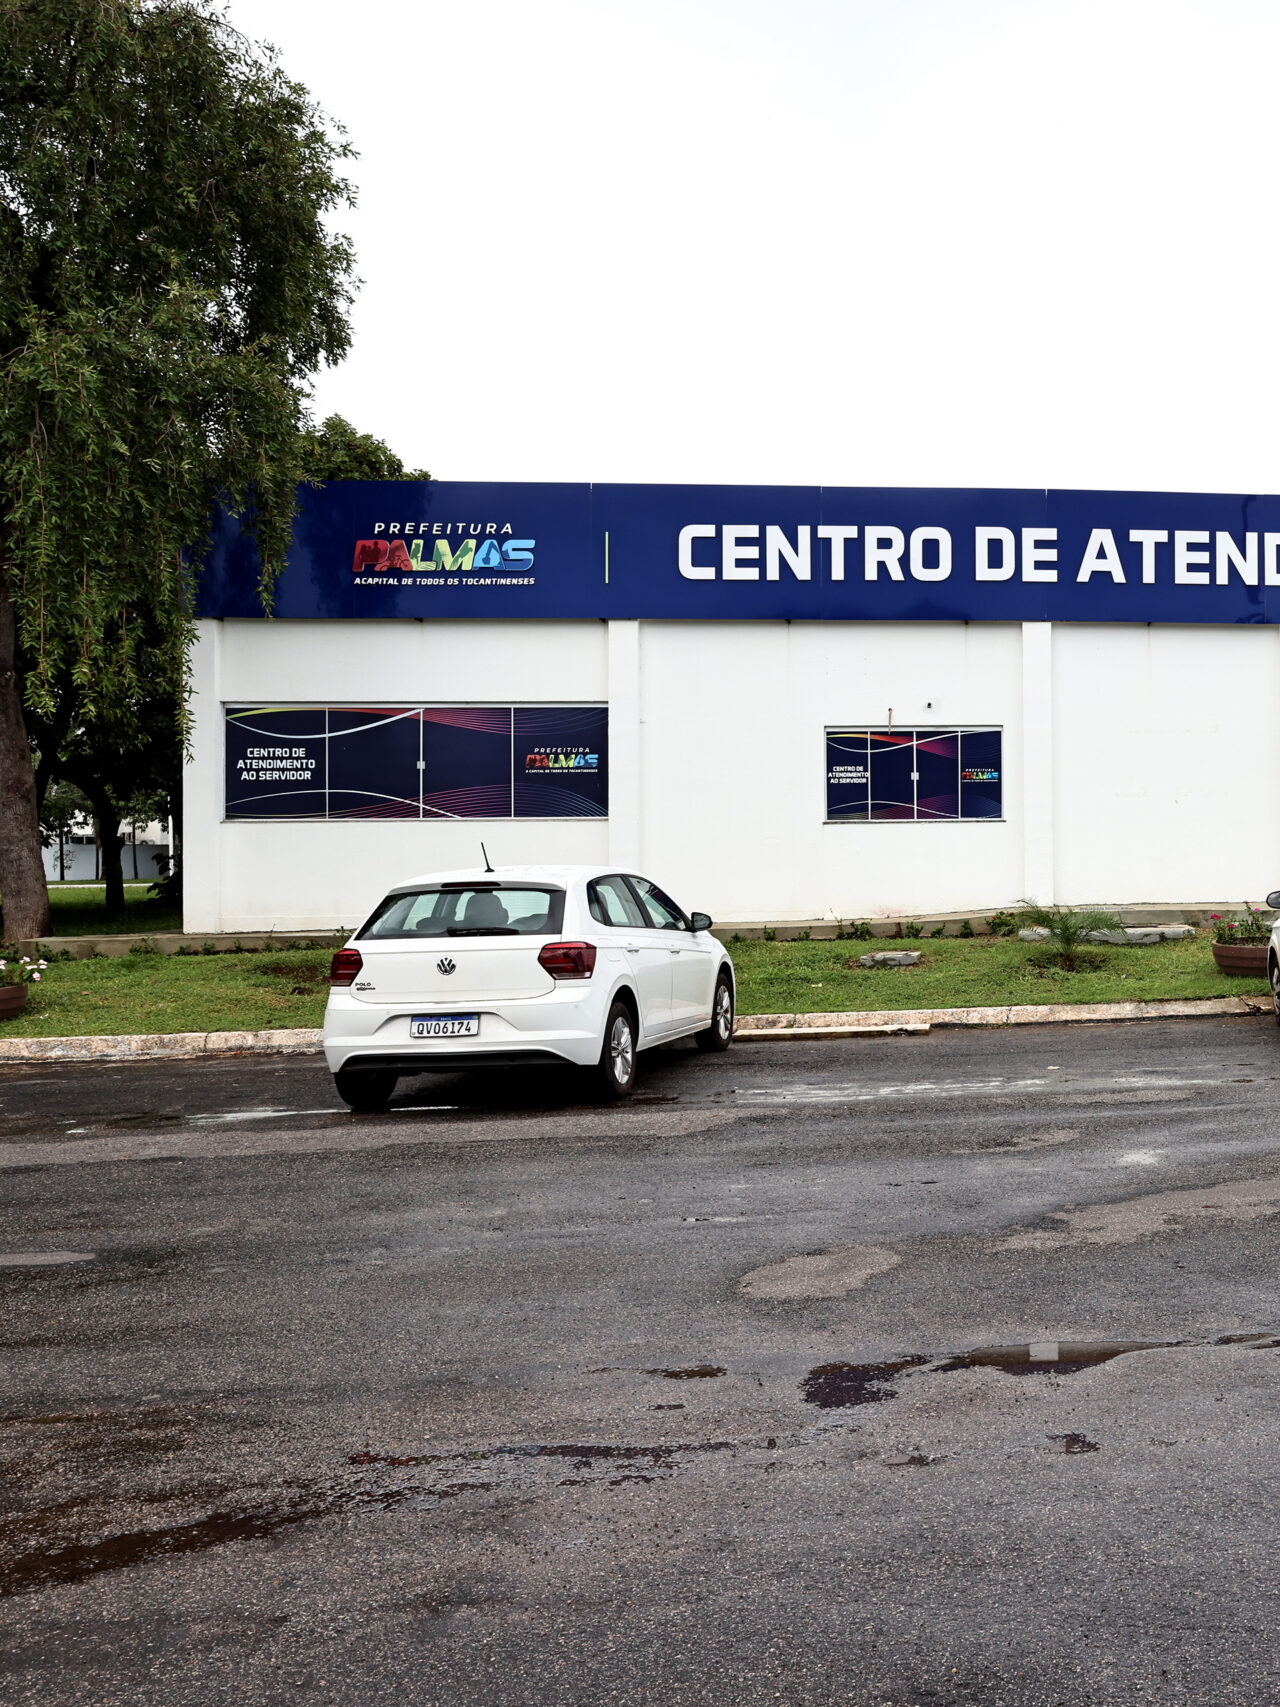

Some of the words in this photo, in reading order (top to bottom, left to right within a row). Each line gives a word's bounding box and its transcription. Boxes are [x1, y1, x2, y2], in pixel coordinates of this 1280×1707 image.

[375, 523, 512, 534] PREFEITURA
[352, 539, 536, 572] PALMAS
[679, 525, 952, 581] CENTRO
[976, 527, 1057, 582] DE
[362, 577, 399, 585] CAPITAL
[416, 578, 445, 586] TODOS
[447, 578, 459, 586] OS
[462, 577, 535, 586] TOCANTINENSES
[247, 748, 289, 757] CENTRO
[292, 748, 305, 757] DE
[237, 760, 315, 768] ATENDIMENTO
[526, 754, 598, 768] PALMAS
[241, 771, 256, 780] AO
[259, 771, 311, 780] SERVIDOR
